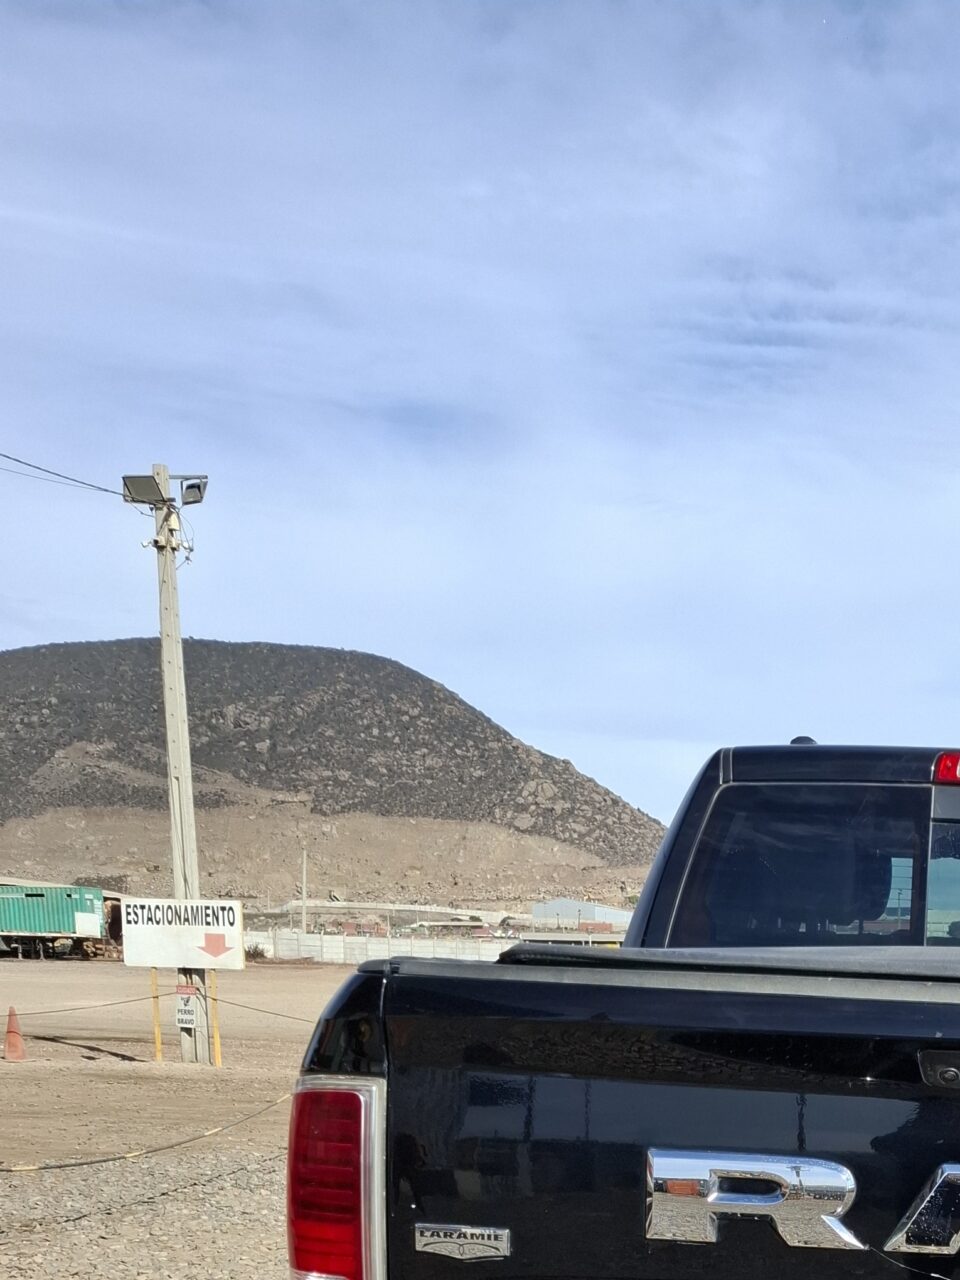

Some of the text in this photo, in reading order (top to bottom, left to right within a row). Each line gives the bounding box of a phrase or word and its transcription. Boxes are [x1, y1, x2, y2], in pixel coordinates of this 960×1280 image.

[125, 904, 235, 927] ESTACIONAMIENTO
[177, 1008, 195, 1016] PERRO
[177, 1018, 195, 1026] BRAVO
[419, 1229, 504, 1242] LARAMIE
